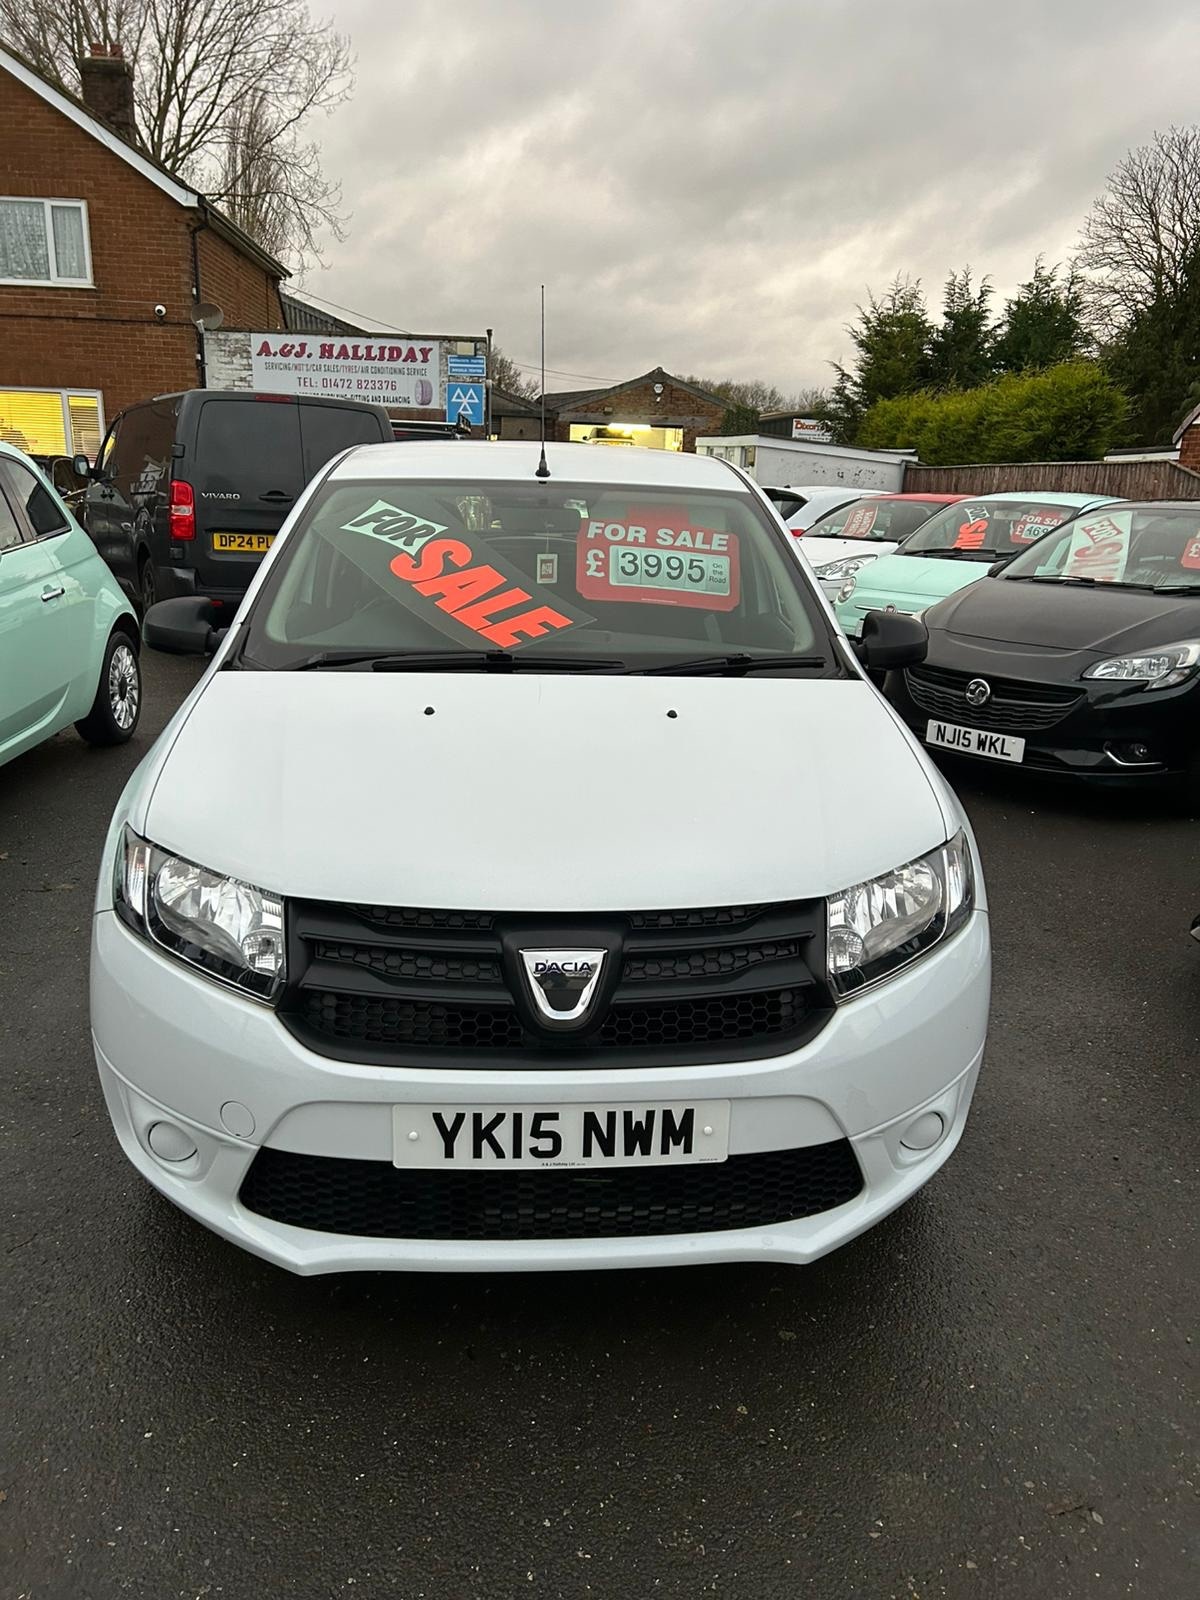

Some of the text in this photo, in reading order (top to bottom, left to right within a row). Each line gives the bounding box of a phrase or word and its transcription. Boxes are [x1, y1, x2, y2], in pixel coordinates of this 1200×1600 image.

[319, 343, 434, 364] HALLIDAY
[370, 366, 405, 376] CONDITIONING
[406, 367, 427, 377] SERVICE
[297, 377, 397, 391] TEL: 01472 823376
[371, 395, 381, 403] AND
[382, 396, 411, 404] BALANCING
[201, 492, 241, 500] VIVARO
[1020, 514, 1041, 524] FOR
[350, 509, 436, 547] FOR
[1015, 525, 1024, 535] £
[1088, 519, 1119, 543] FOR
[219, 534, 253, 548] DP24
[587, 521, 729, 551] FOR SALE
[585, 548, 605, 578] £
[620, 551, 706, 583] 3995
[708, 575, 727, 584] Road
[389, 538, 574, 648] SALE
[936, 724, 1011, 757] NJ15 WKL
[534, 962, 592, 972] DACIA
[432, 1107, 695, 1160] YK15 NWM
